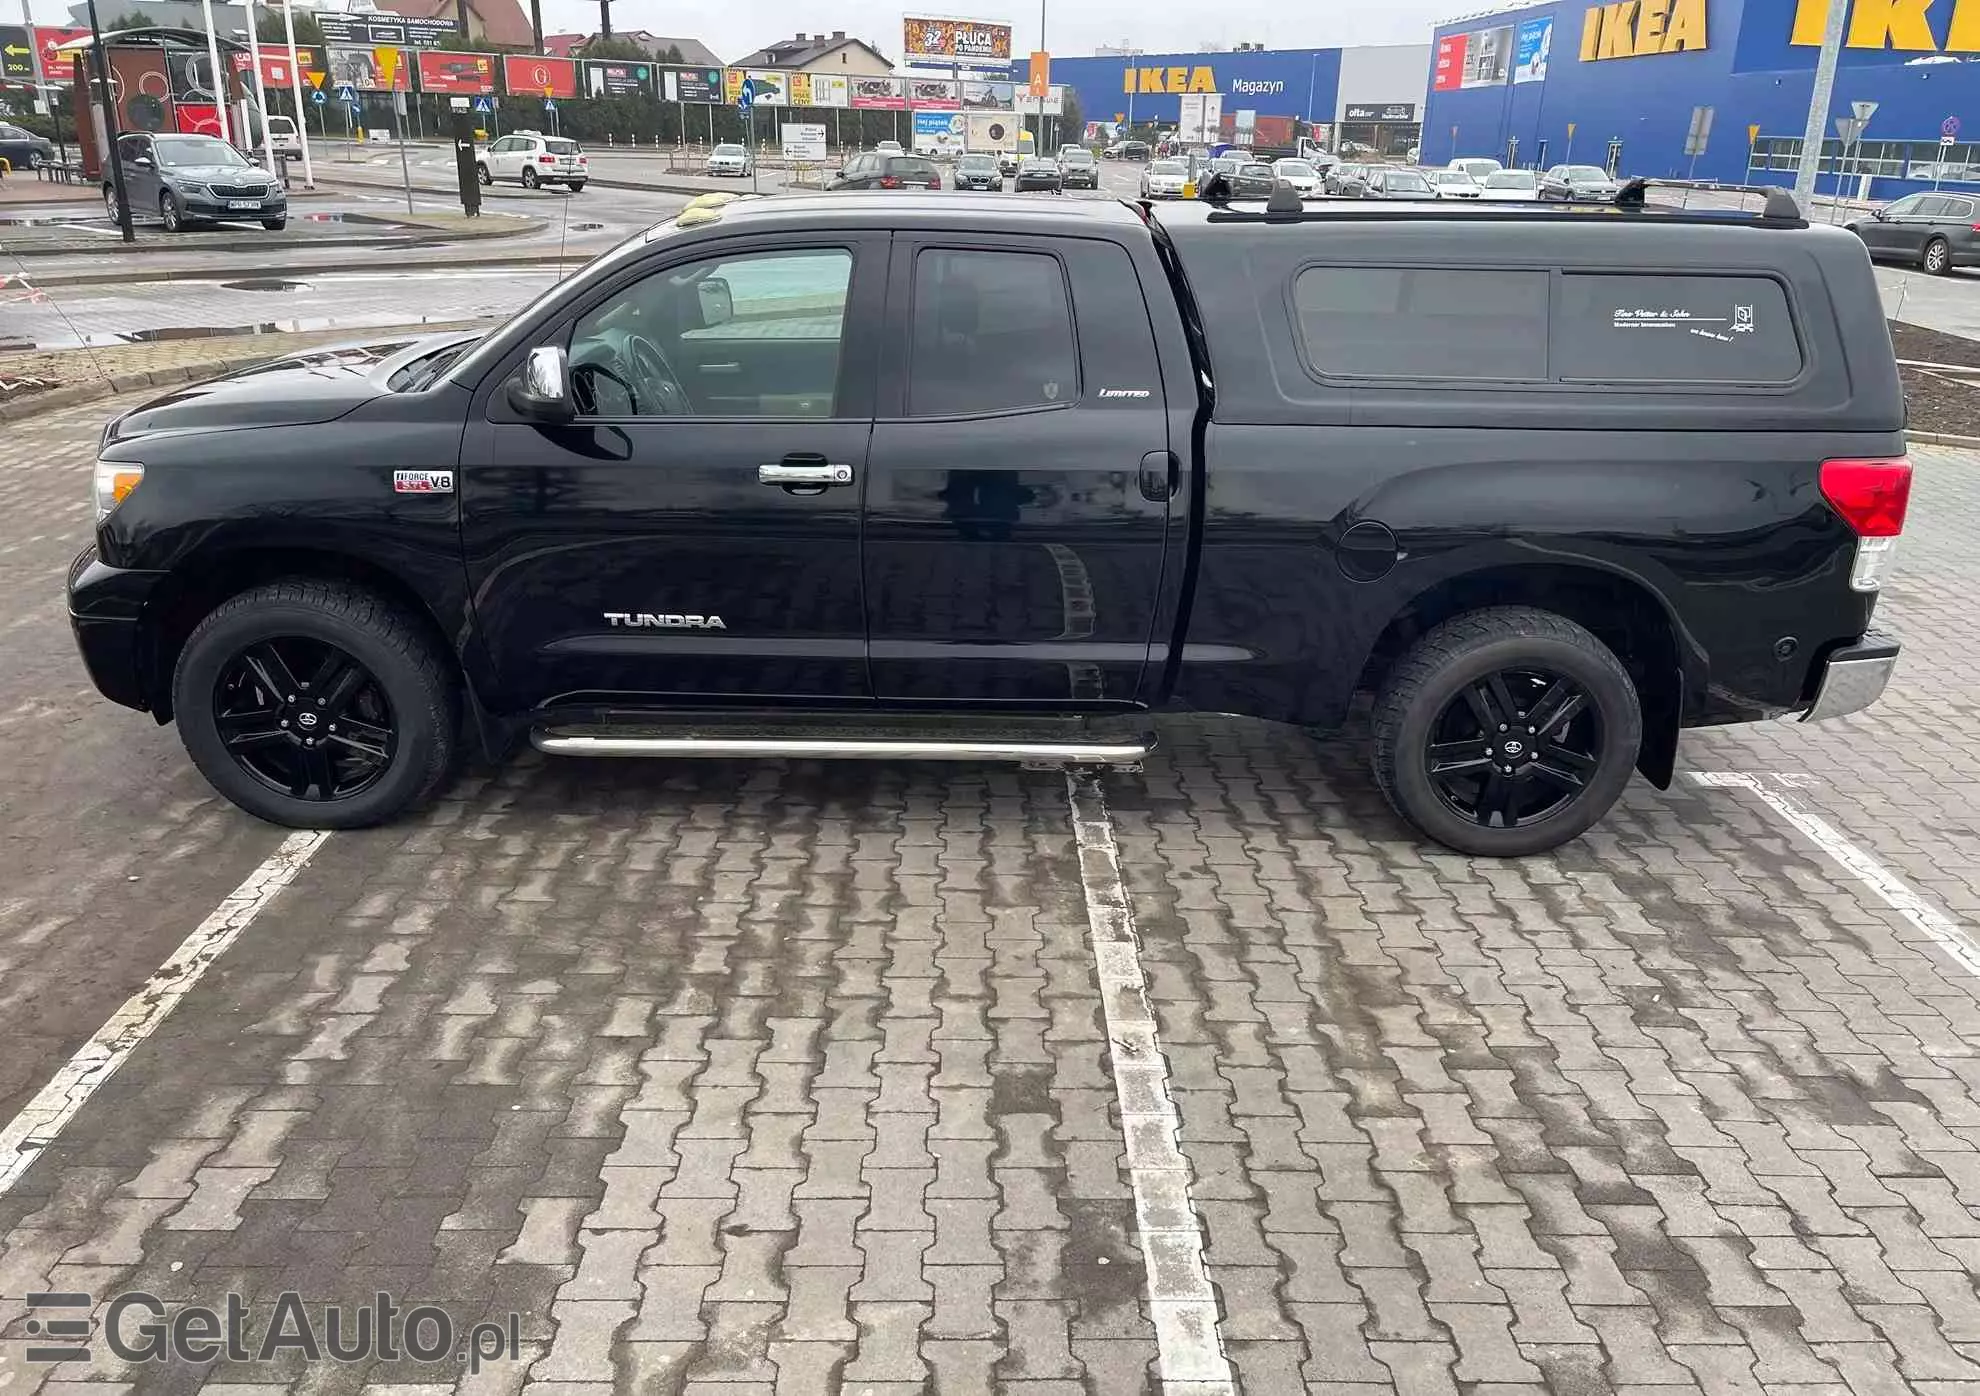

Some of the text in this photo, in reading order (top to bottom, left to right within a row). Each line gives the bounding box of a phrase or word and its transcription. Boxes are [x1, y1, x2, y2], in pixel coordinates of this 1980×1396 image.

[367, 15, 454, 27] KOSMETYKA SAMOCHODOWA
[955, 31, 992, 47] PŁUCA
[1579, 0, 1707, 62] IKEA
[7, 63, 24, 72] 200
[1124, 66, 1217, 93] IKEA
[1232, 79, 1284, 96] Magazyn
[430, 476, 451, 488] V8
[603, 612, 728, 630] TUNDRA
